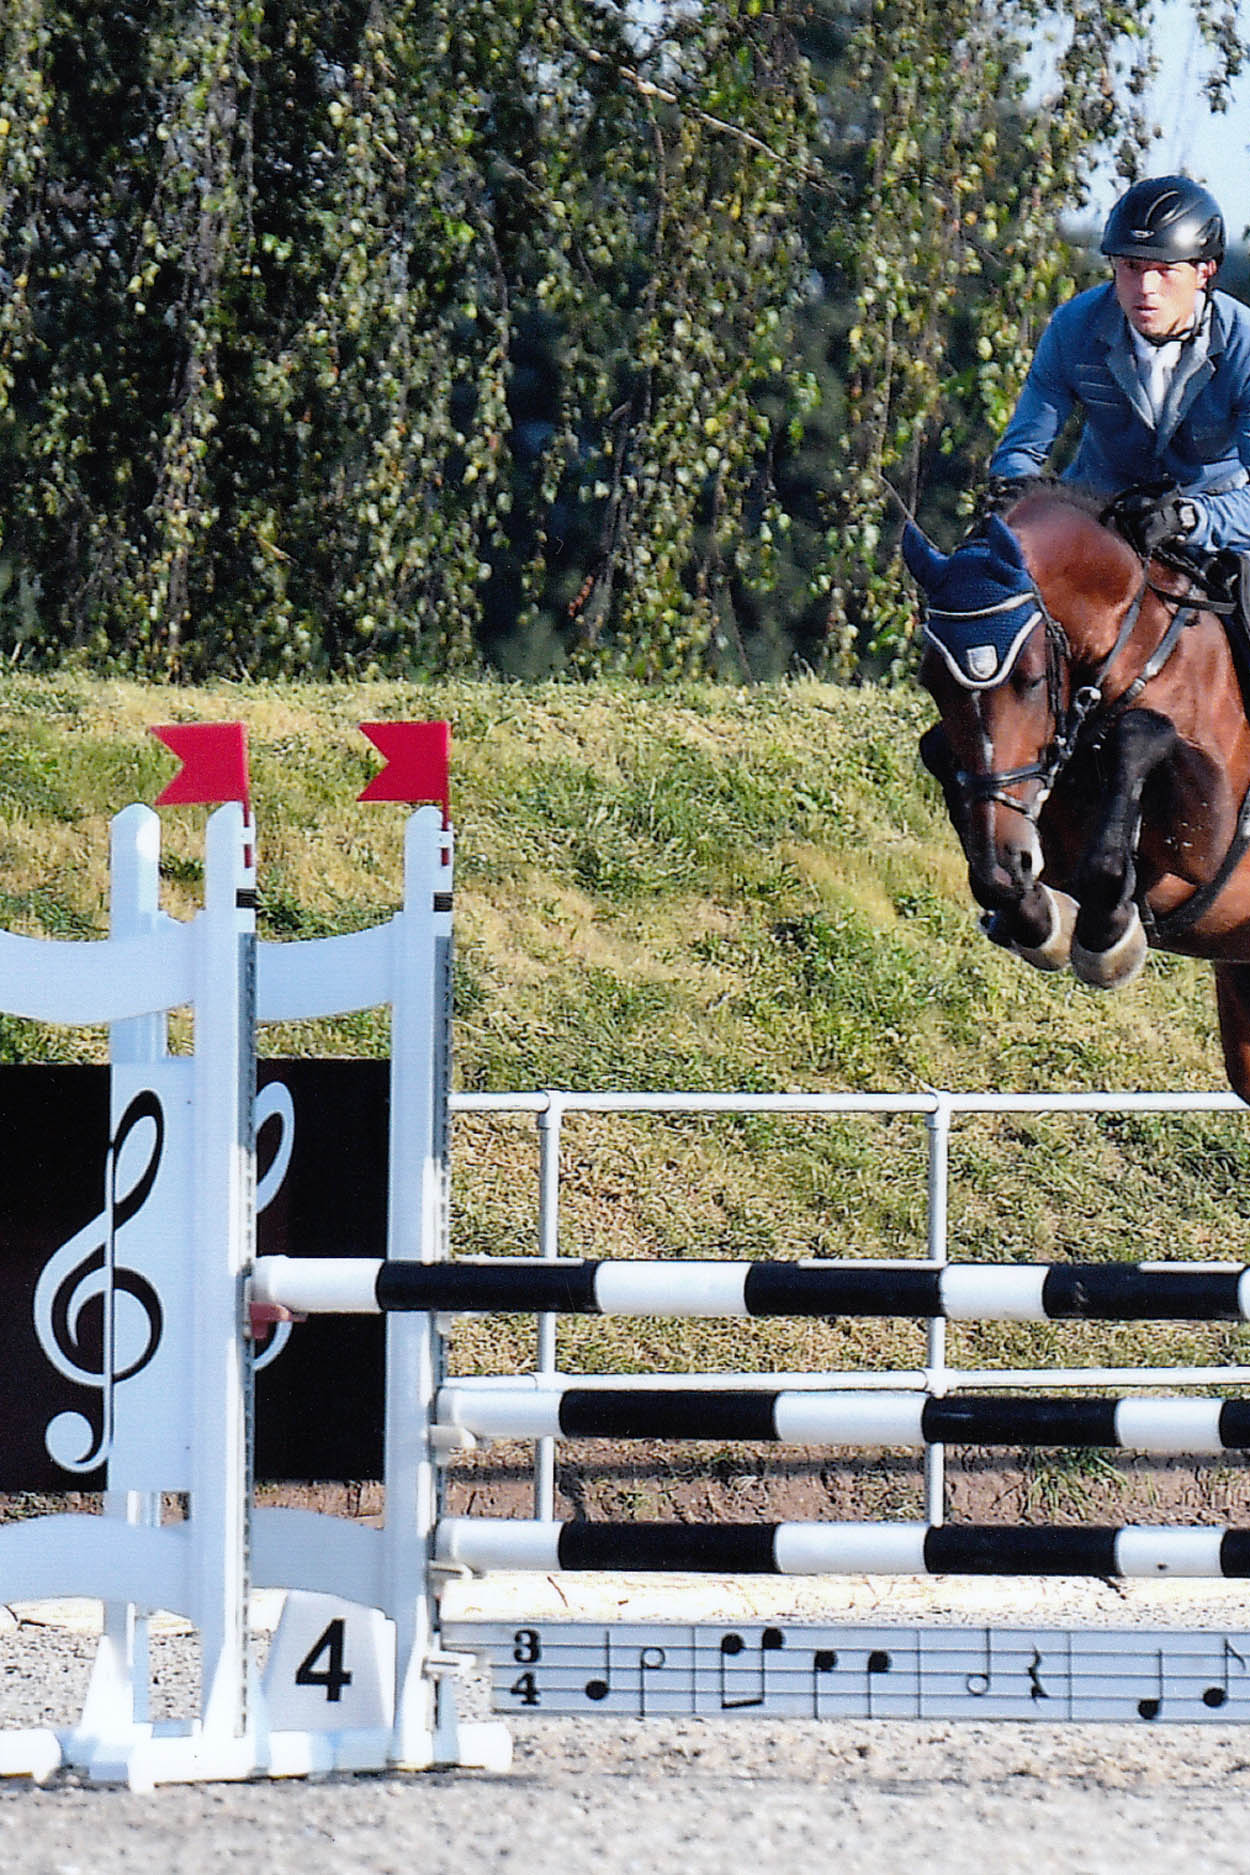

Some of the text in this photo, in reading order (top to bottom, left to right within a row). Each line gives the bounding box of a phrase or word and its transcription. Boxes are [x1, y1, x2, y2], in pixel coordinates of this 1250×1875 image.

[295, 1617, 353, 1702] 4
[513, 1629, 541, 1664] 3
[510, 1671, 541, 1706] 4
